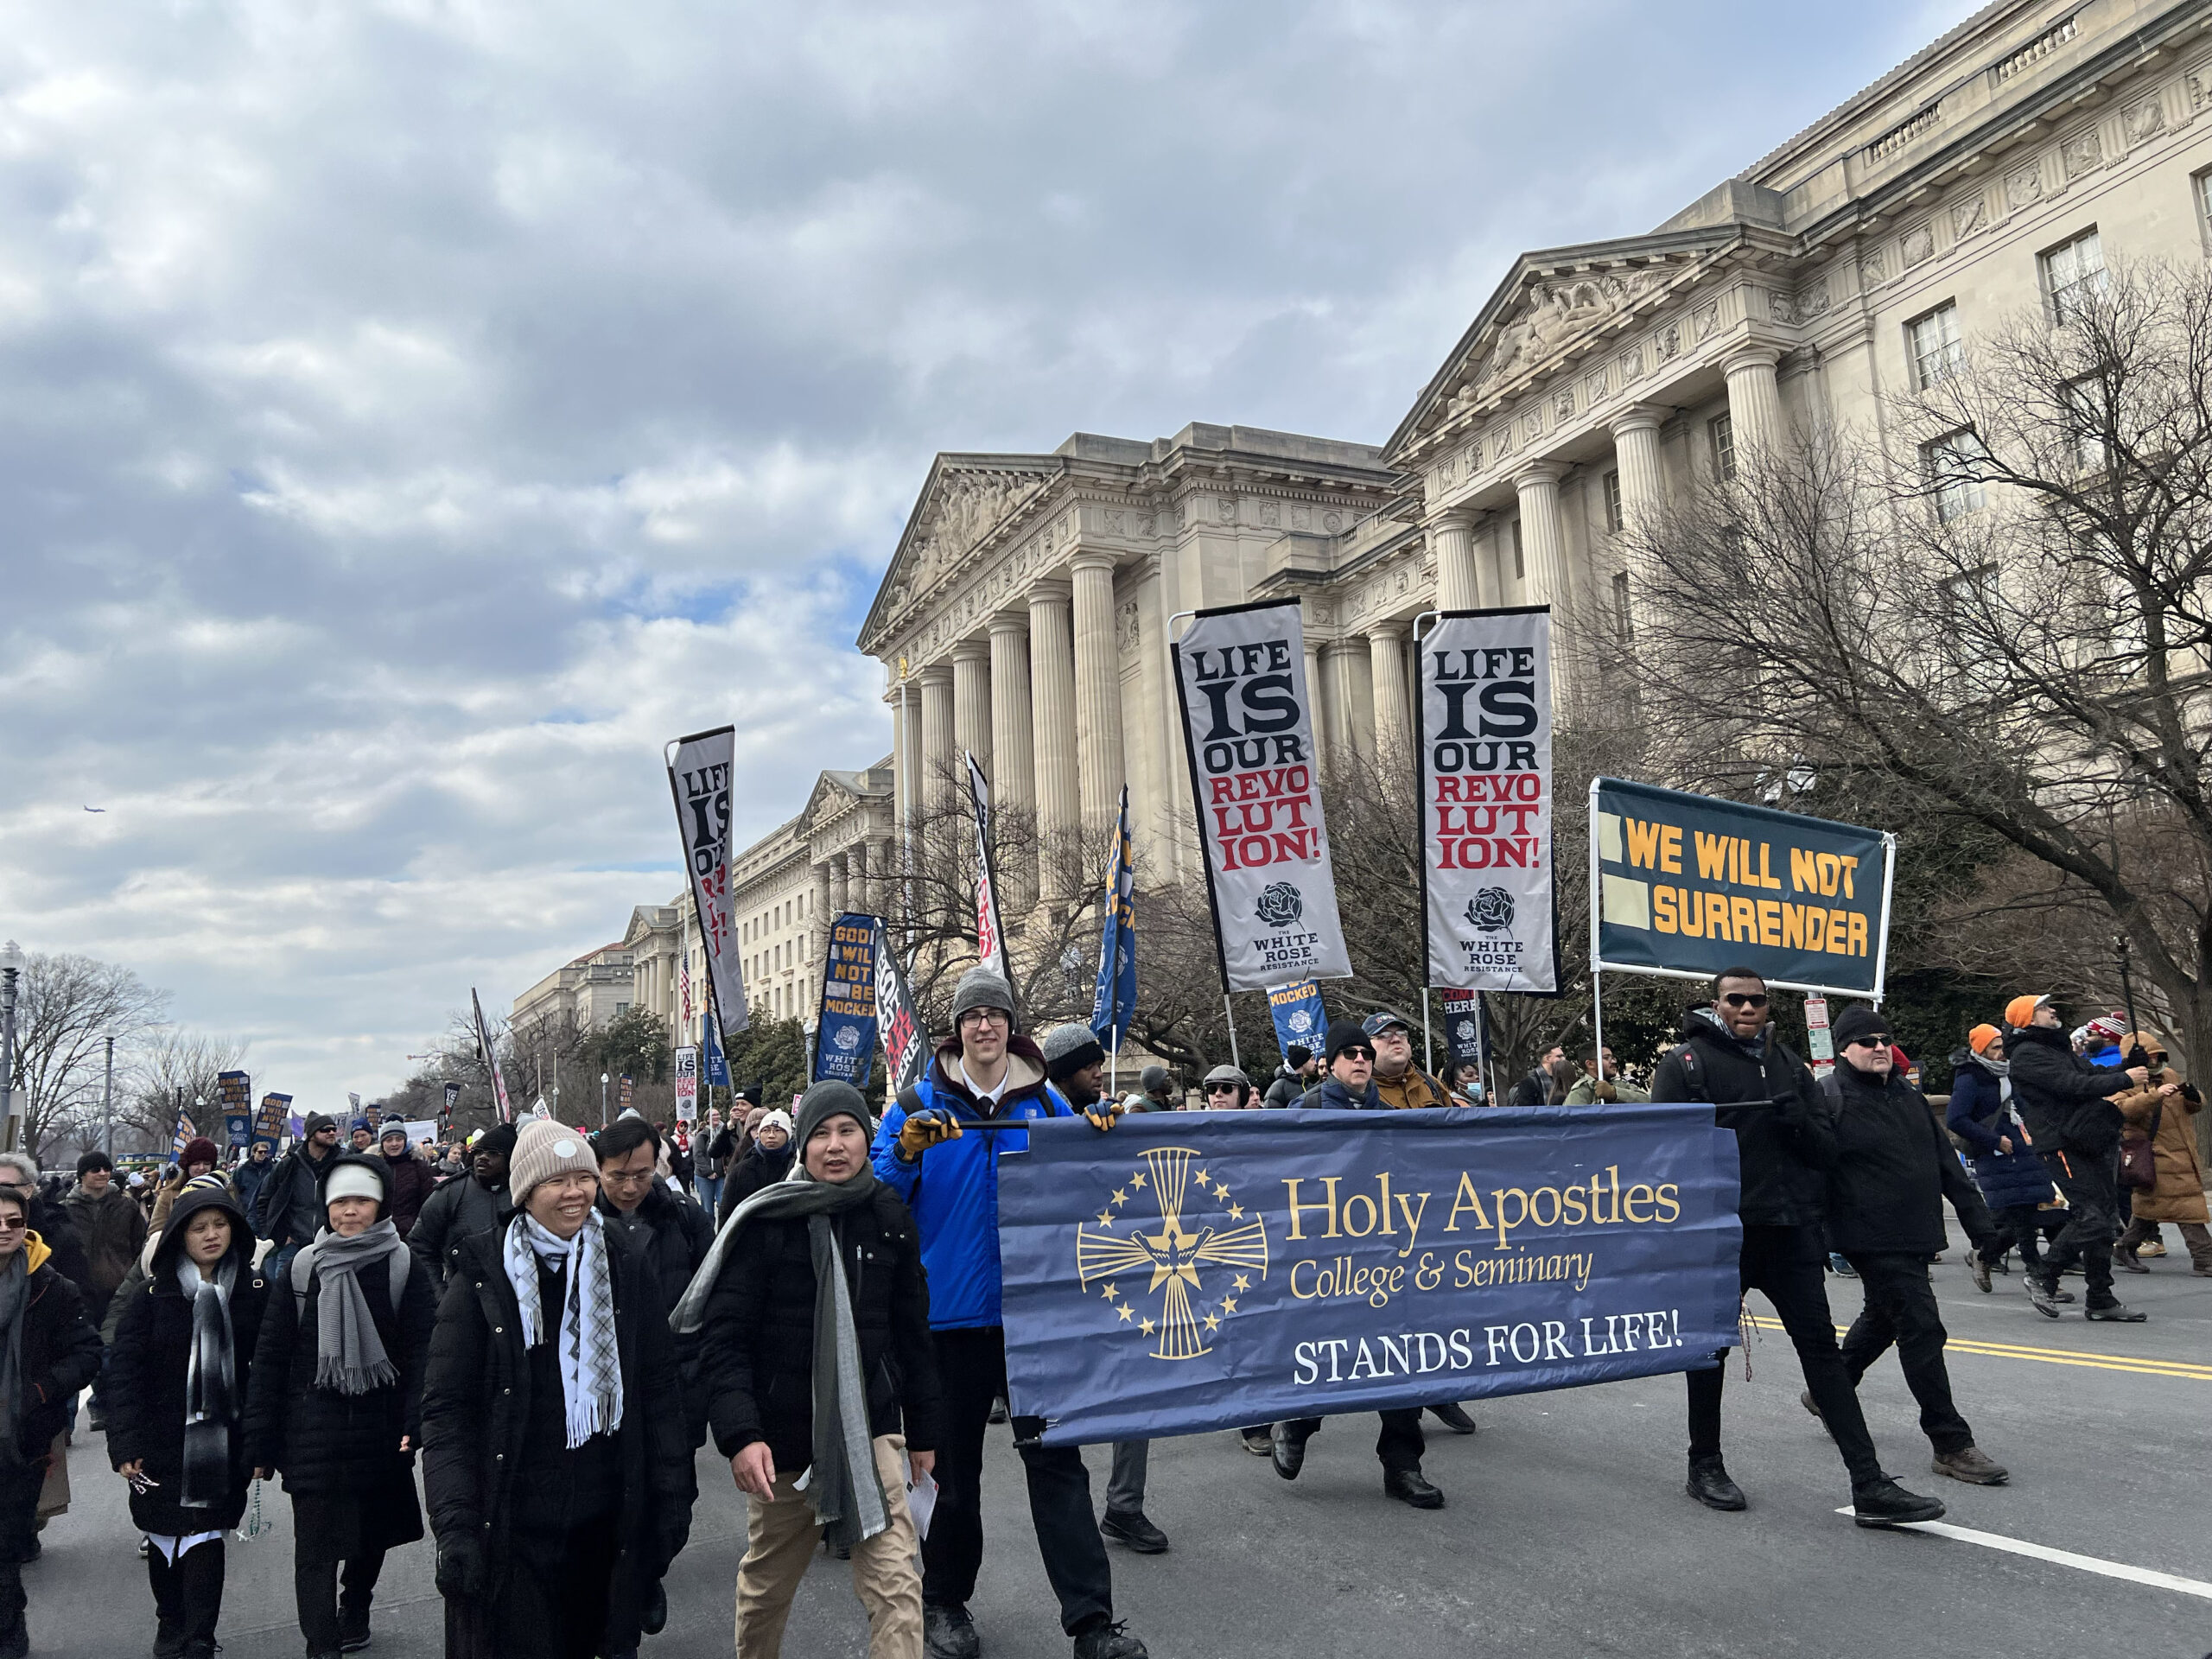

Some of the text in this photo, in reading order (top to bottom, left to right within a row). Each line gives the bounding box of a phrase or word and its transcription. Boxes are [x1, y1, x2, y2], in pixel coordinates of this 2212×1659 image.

[1190, 639, 1291, 682] LIFE
[1433, 646, 1535, 680] LIFE
[1197, 672, 1300, 741] IS
[1434, 680, 1538, 741] IS
[1204, 734, 1307, 773] OUR
[1433, 741, 1540, 772] OUR
[1209, 765, 1309, 804] REVO
[1434, 773, 1541, 802] REVO
[1212, 794, 1312, 837] LUT
[1435, 804, 1539, 836] LUT
[1217, 827, 1320, 871] ION!
[1435, 837, 1539, 869] ION!
[1625, 817, 1858, 899] WE WILL NOT
[835, 926, 868, 944] GOD
[1653, 885, 1867, 957] SURRENDER
[842, 947, 871, 963] WIL
[1254, 932, 1319, 951] WHITE
[1265, 946, 1312, 963] ROSE
[1459, 941, 1523, 952] WHITE
[835, 963, 871, 983] NOT
[1260, 958, 1319, 971] RESISTANCE
[1470, 954, 1516, 964] ROSE
[825, 999, 876, 1017] MOCKED
[851, 985, 874, 1001] BE
[1269, 984, 1317, 1007] MOCKED
[1287, 1033, 1324, 1046] WHITE
[677, 1060, 695, 1071] IS
[825, 1053, 864, 1065] WHITE
[830, 1063, 858, 1072] ROSE
[1281, 1165, 1681, 1257] Holy Apostles
[1290, 1246, 1593, 1307] College & Seminary
[1294, 1308, 1684, 1385] STANDS FOR LIFE!
